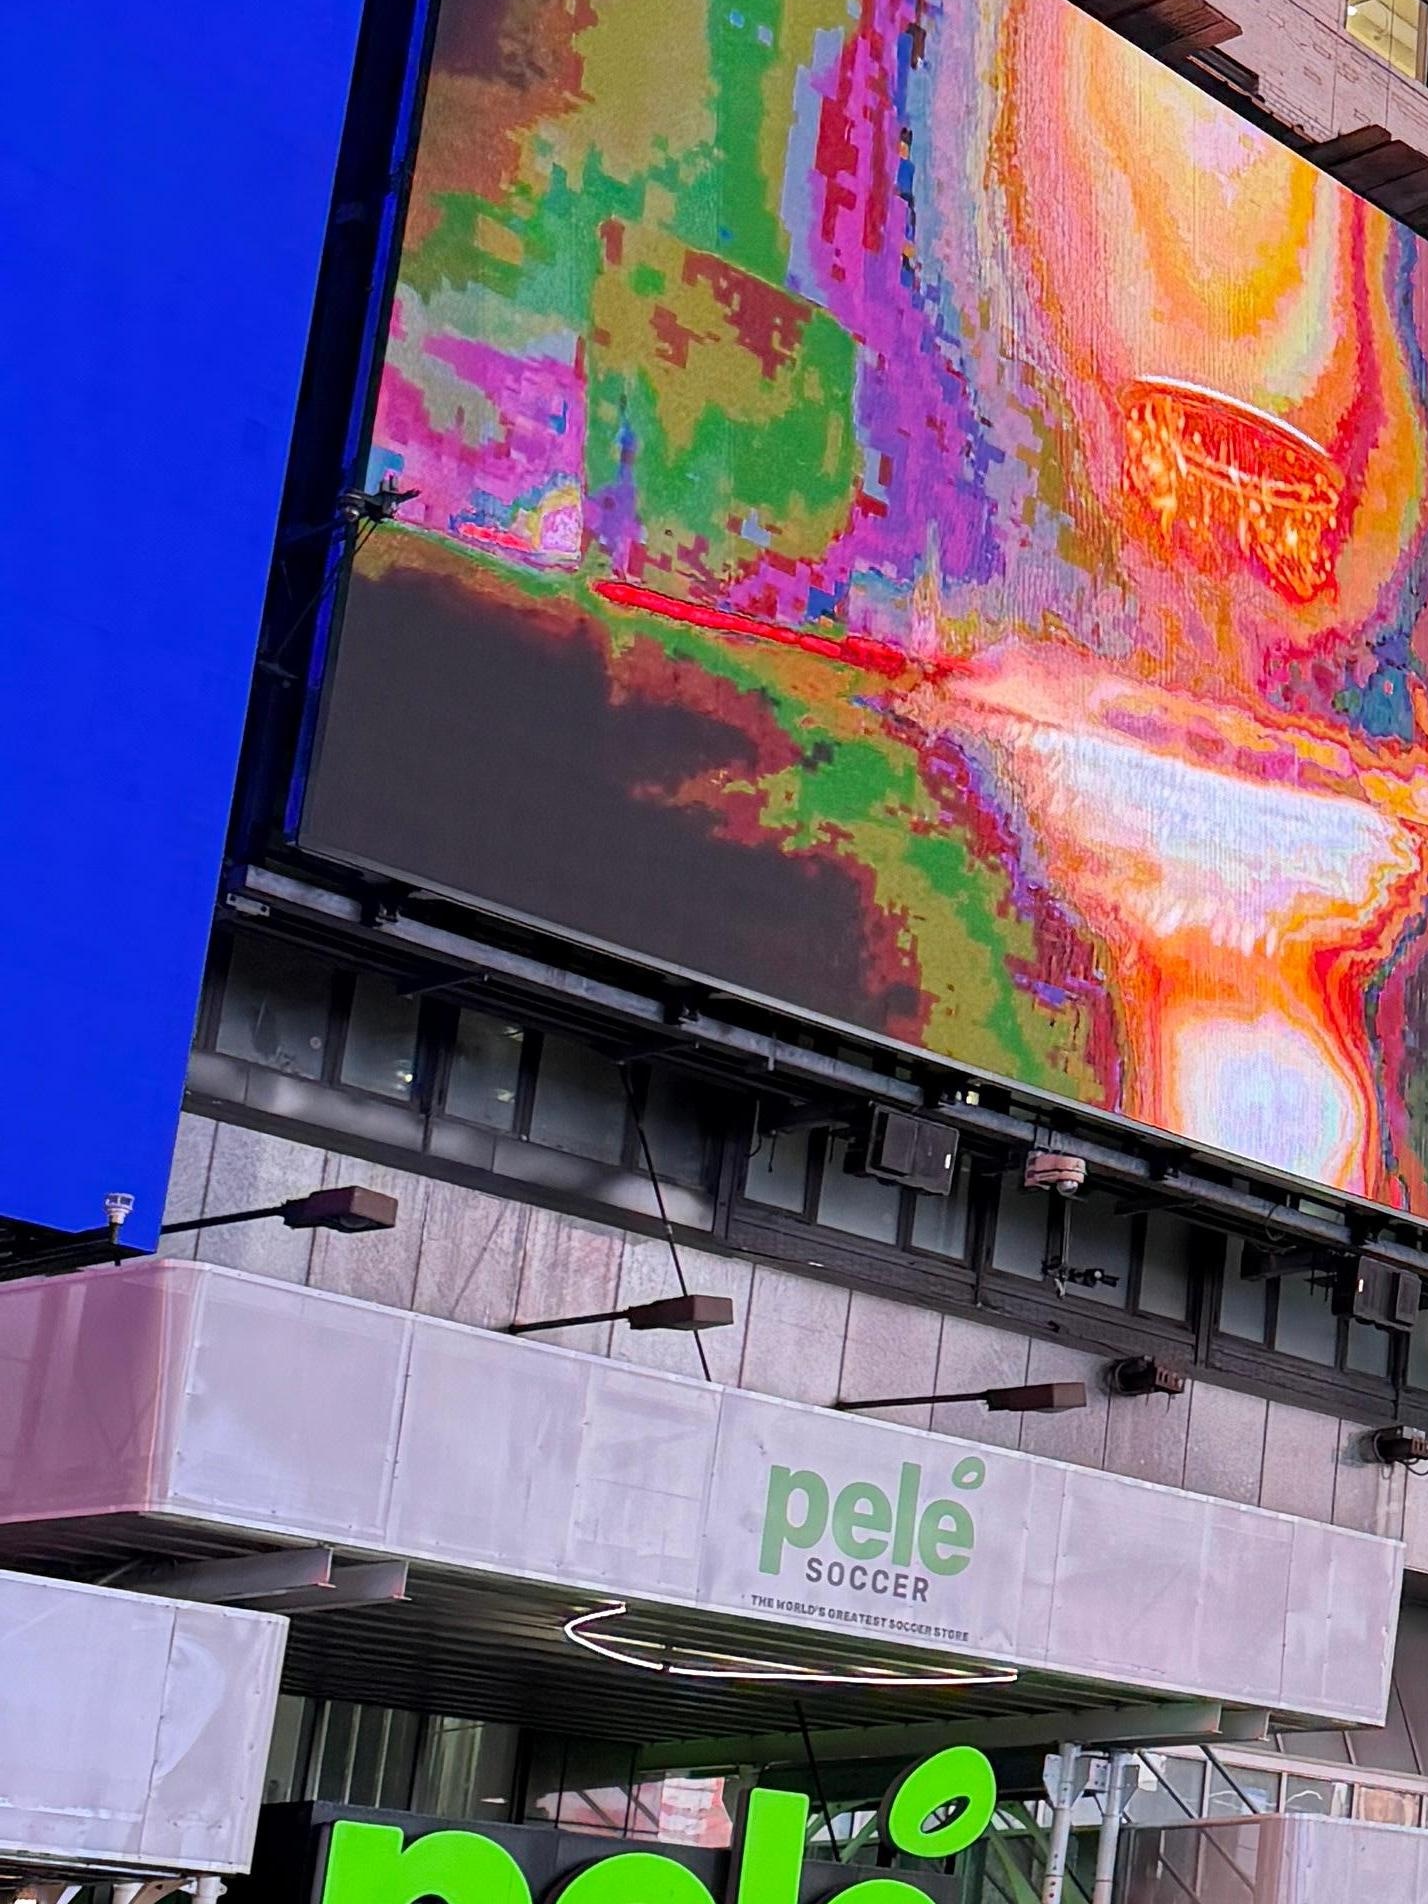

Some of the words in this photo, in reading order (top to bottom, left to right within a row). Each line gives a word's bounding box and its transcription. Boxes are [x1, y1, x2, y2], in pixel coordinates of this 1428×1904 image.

[759, 1456, 986, 1575] pelé
[805, 1557, 930, 1602] SOCCER
[751, 1594, 774, 1610] THE
[776, 1599, 826, 1618] WORLD'S
[828, 1608, 887, 1629] GREATEST
[888, 1619, 932, 1636] SOCCER
[934, 1626, 969, 1642] STORE
